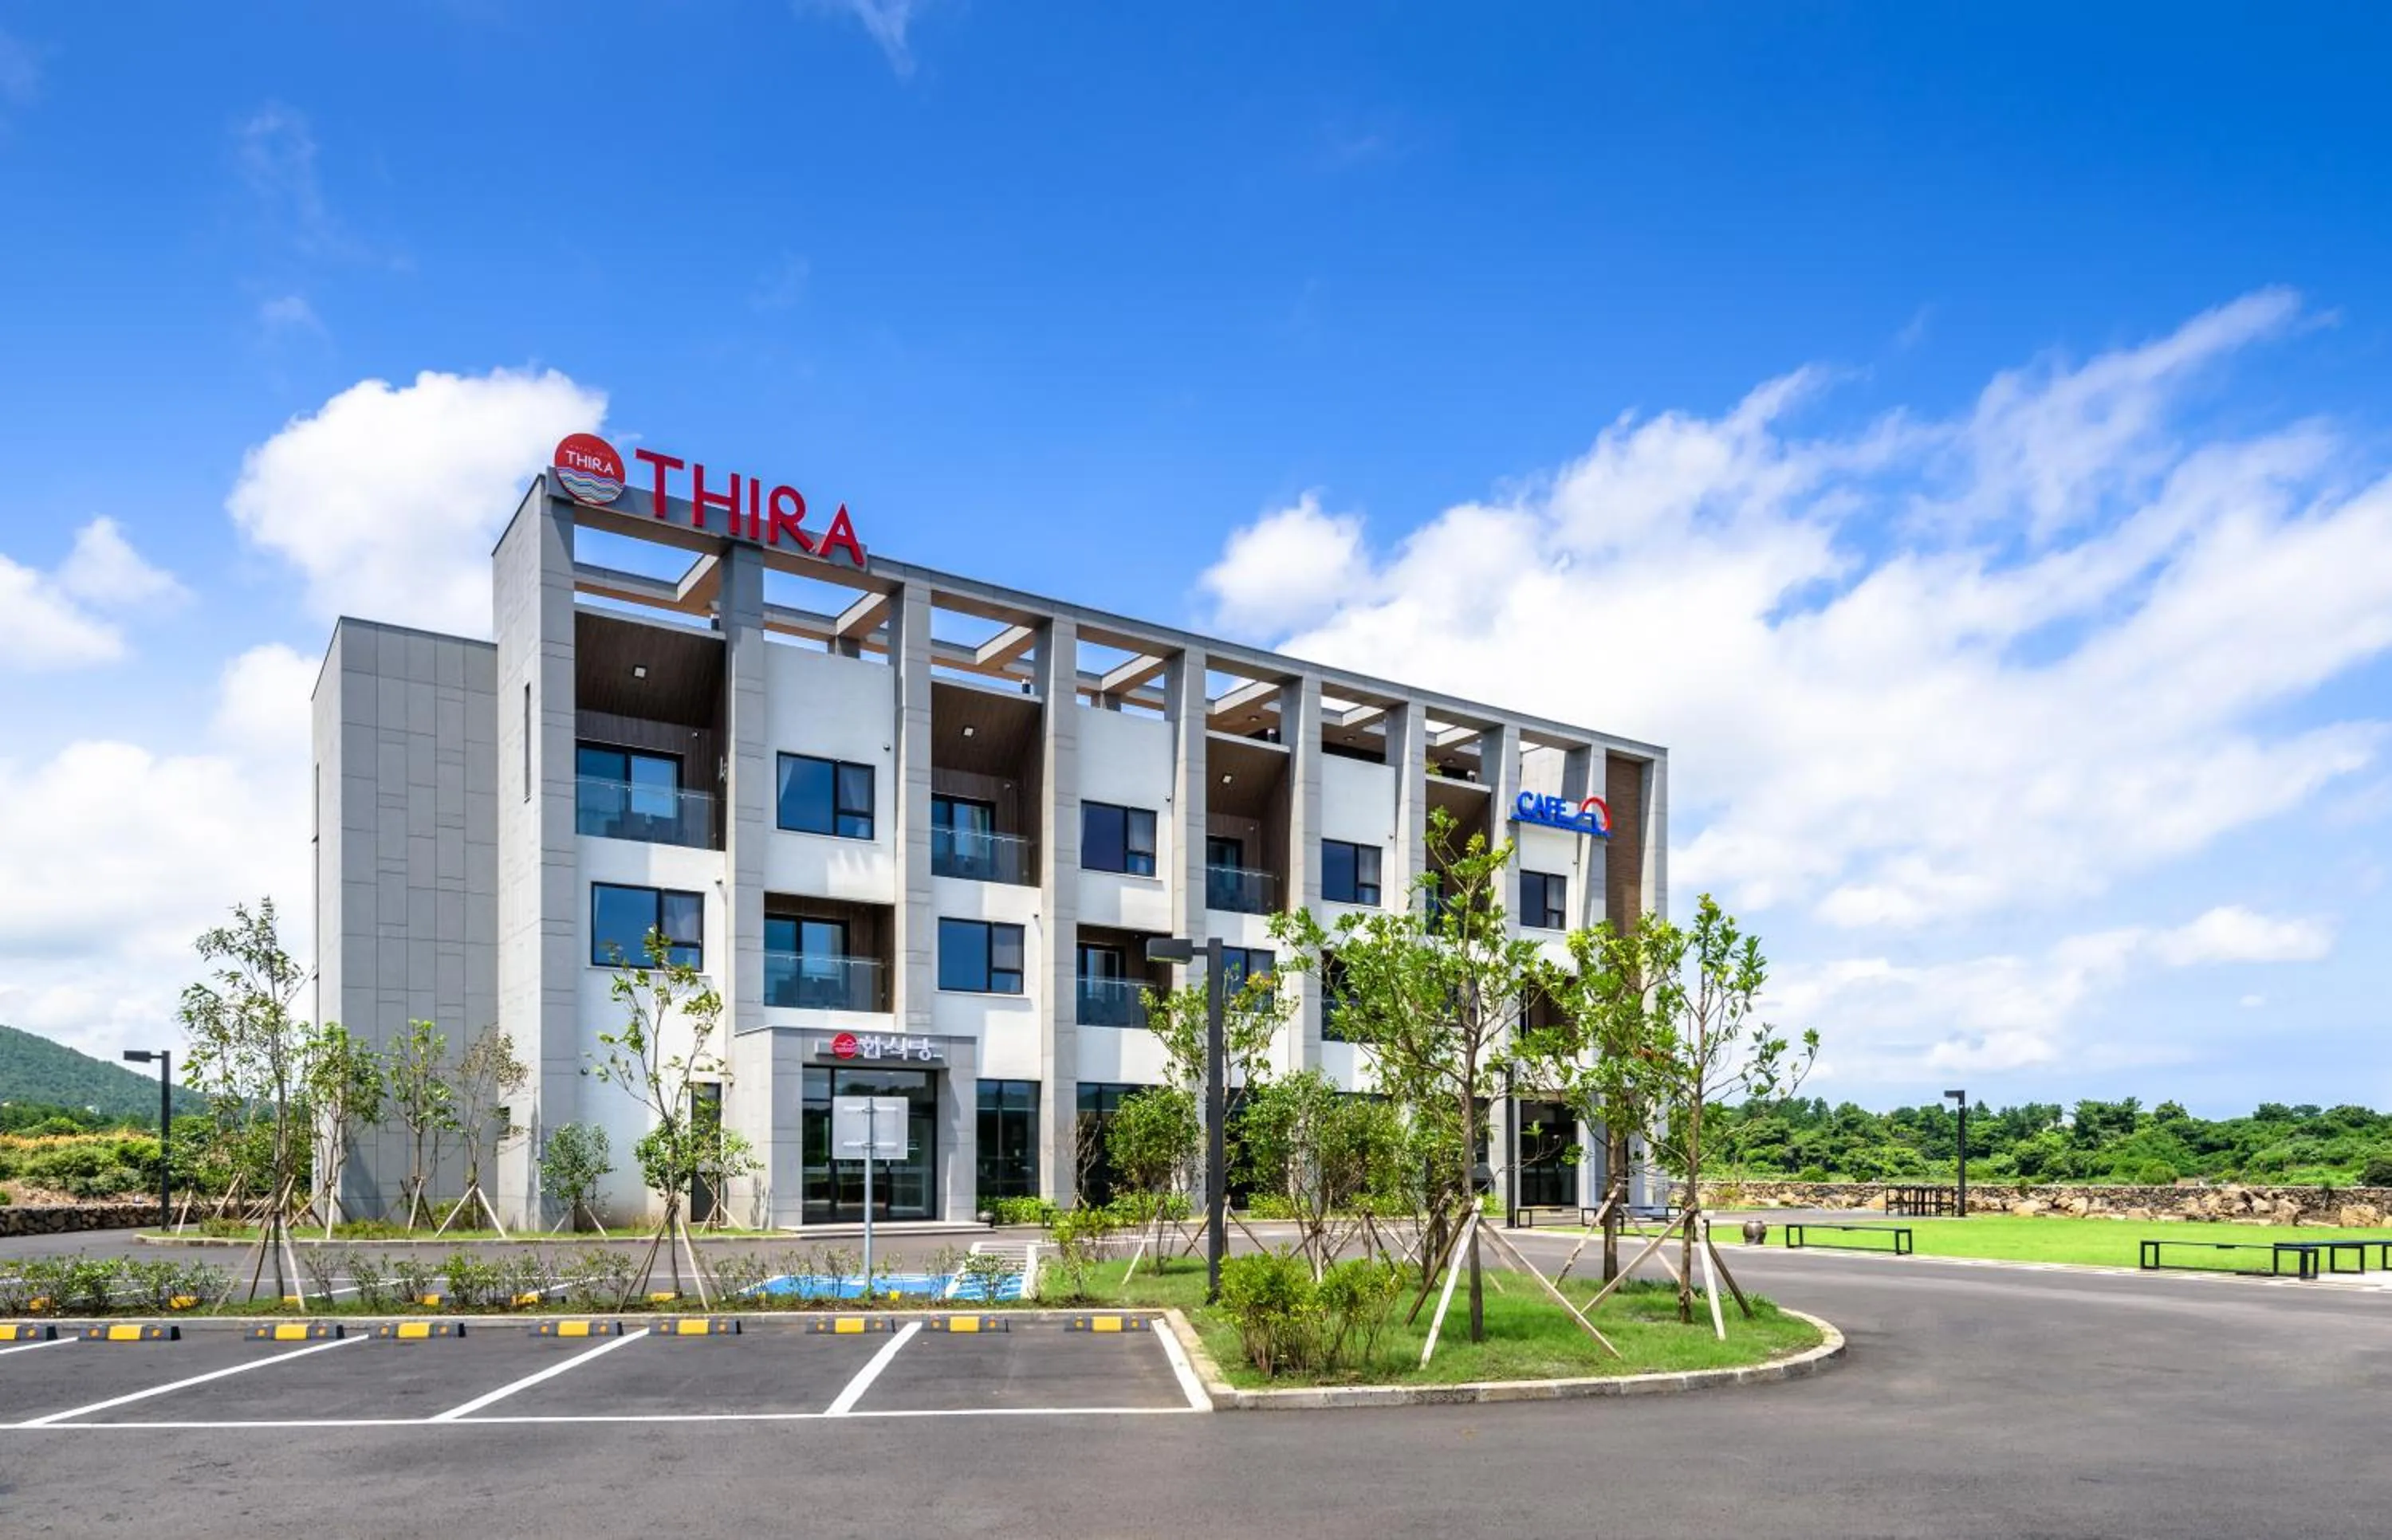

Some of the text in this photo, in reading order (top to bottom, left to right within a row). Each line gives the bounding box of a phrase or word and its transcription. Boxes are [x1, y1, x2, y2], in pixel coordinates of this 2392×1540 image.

[565, 450, 614, 475] THIRA
[635, 447, 864, 566] THIRA
[1517, 791, 1567, 821] CAFE
